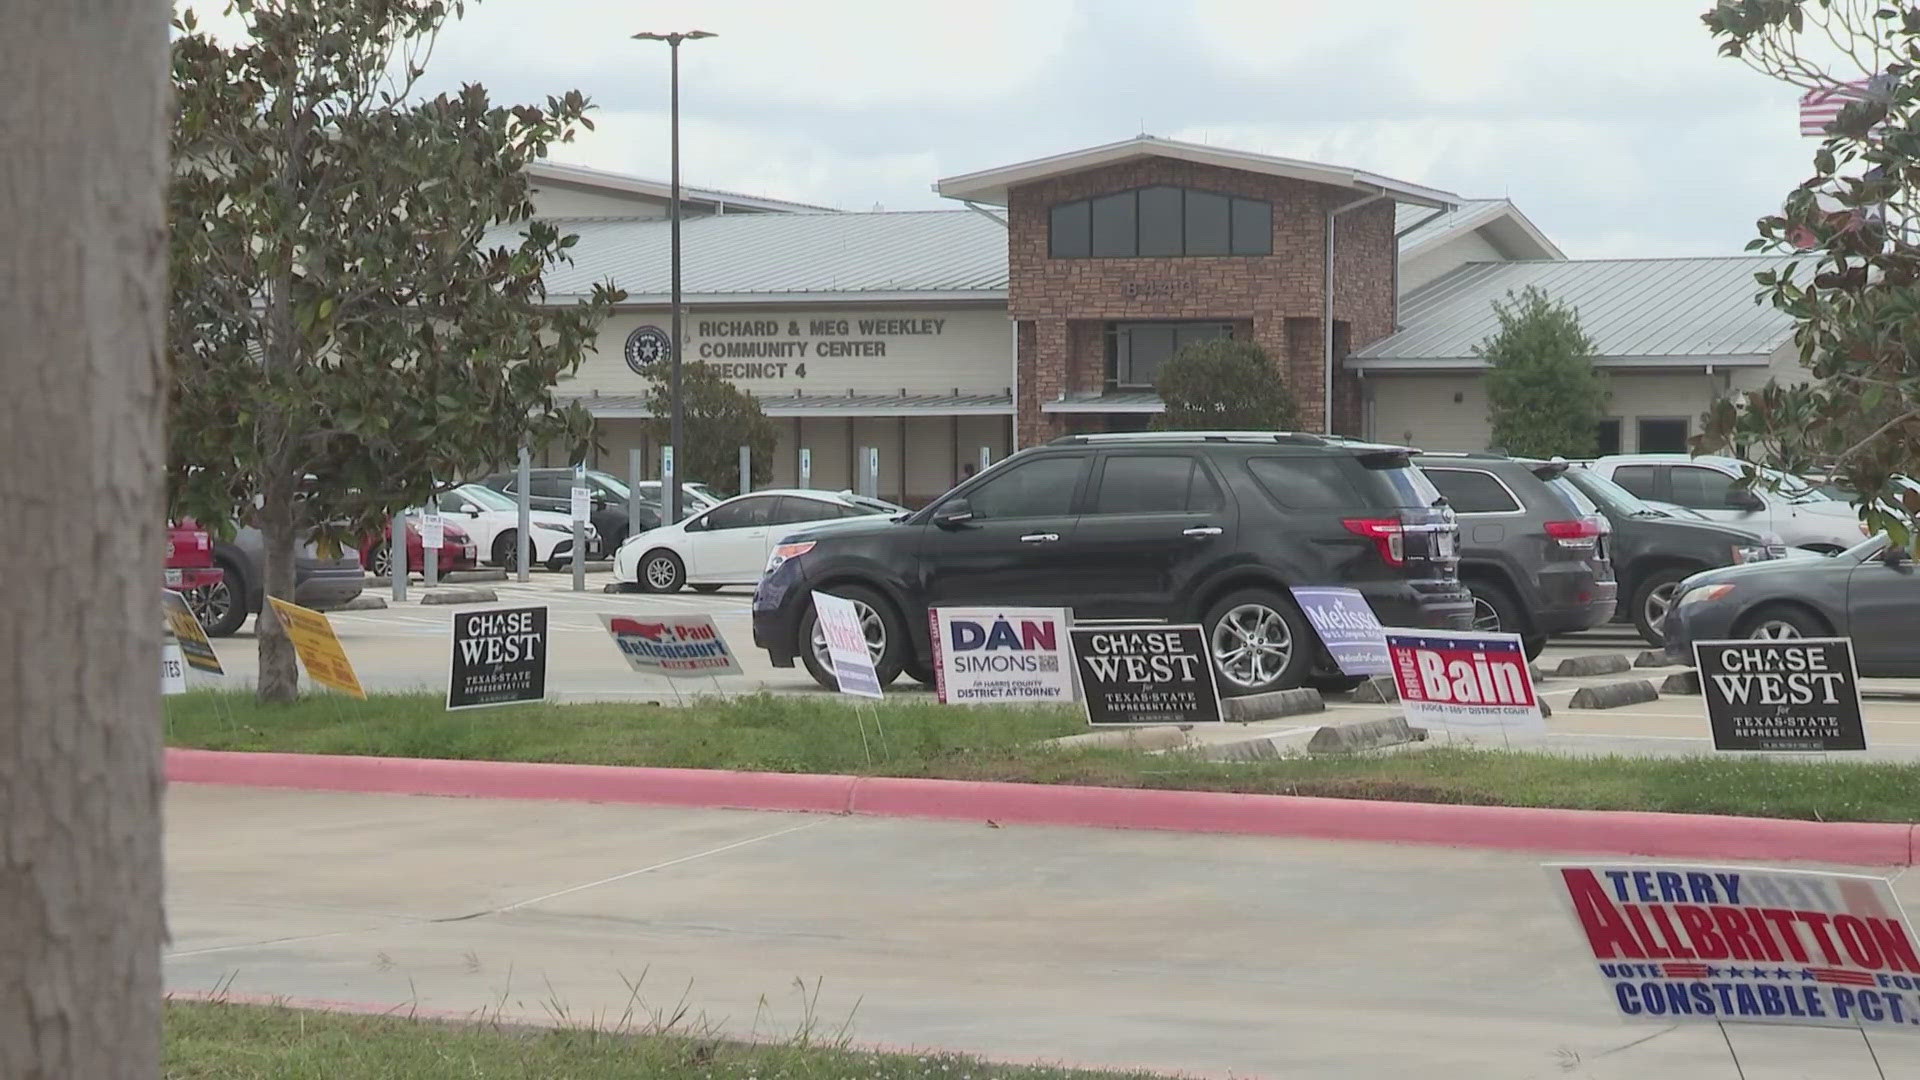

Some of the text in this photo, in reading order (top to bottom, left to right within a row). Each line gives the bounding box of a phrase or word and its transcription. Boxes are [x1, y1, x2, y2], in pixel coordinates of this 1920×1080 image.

[699, 319, 945, 337] RICHARD & MEG WEEKLEY
[700, 341, 886, 358] COMMUNITY CENTER
[703, 362, 806, 379] RECINCT 4
[468, 612, 532, 637] CHASE
[1305, 604, 1381, 631] Melissa
[675, 624, 716, 641] Paul
[950, 620, 1057, 651] DAN
[459, 633, 541, 667] WEST
[617, 639, 728, 659] Bettencourt
[1091, 633, 1184, 655] CHASE
[954, 655, 1037, 673] SIMONS
[1084, 654, 1199, 683] WEST
[1721, 647, 1828, 672] CHASE
[466, 671, 531, 686] TEXAS STATE
[1396, 648, 1423, 700] BRUCE
[1415, 649, 1528, 704] Bain
[464, 681, 531, 695] REPRESENTATIVE
[984, 680, 1010, 688] HARRIS
[1711, 672, 1844, 705] WEST
[957, 688, 1061, 699] DISTRICT ATTORNEY
[1105, 692, 1196, 703] TEXAS STATE
[1107, 702, 1197, 712] REPRESENTATIVE
[1776, 704, 1790, 716] for
[1733, 717, 1838, 727] TEXAS STATE
[1735, 728, 1840, 737] REPRESENTATIVE
[1605, 870, 1740, 904] TERRY
[1561, 868, 1920, 975] ALLBRITTON
[1601, 964, 1664, 978] VOTE
[1615, 982, 1919, 1026] CONSTABLE PCT.
